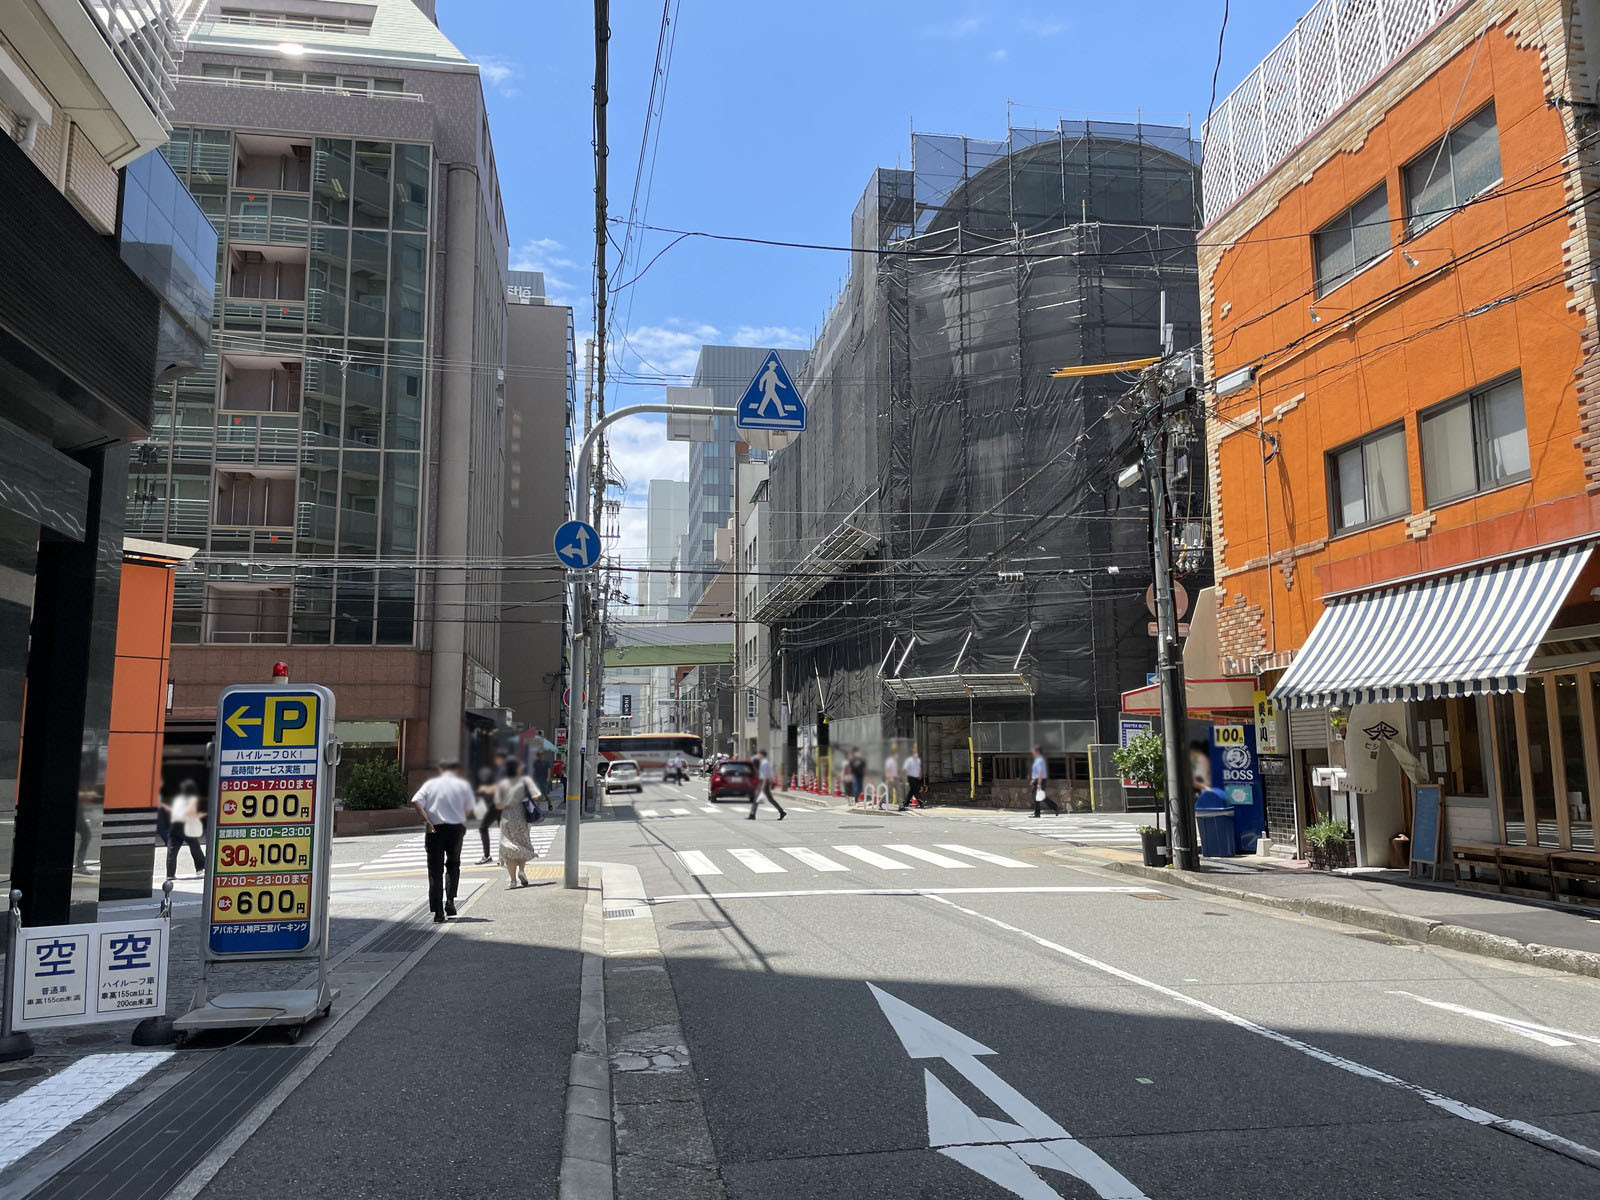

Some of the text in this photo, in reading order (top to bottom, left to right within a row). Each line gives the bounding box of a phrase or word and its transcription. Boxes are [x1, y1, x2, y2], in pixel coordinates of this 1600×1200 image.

[273, 701, 308, 743] P
[236, 750, 303, 760] ハイルーフOK!
[231, 765, 306, 775] 長時間サービス実施!
[1223, 769, 1254, 780] BOSS
[242, 794, 309, 818] 900円
[259, 843, 307, 865] 100円
[237, 890, 305, 914] 600円
[35, 940, 76, 977] 空
[108, 934, 151, 971] 空
[41, 985, 67, 995] 普通車
[102, 977, 155, 988] ハイルーフ車
[101, 989, 153, 1000] 車高155cm以上
